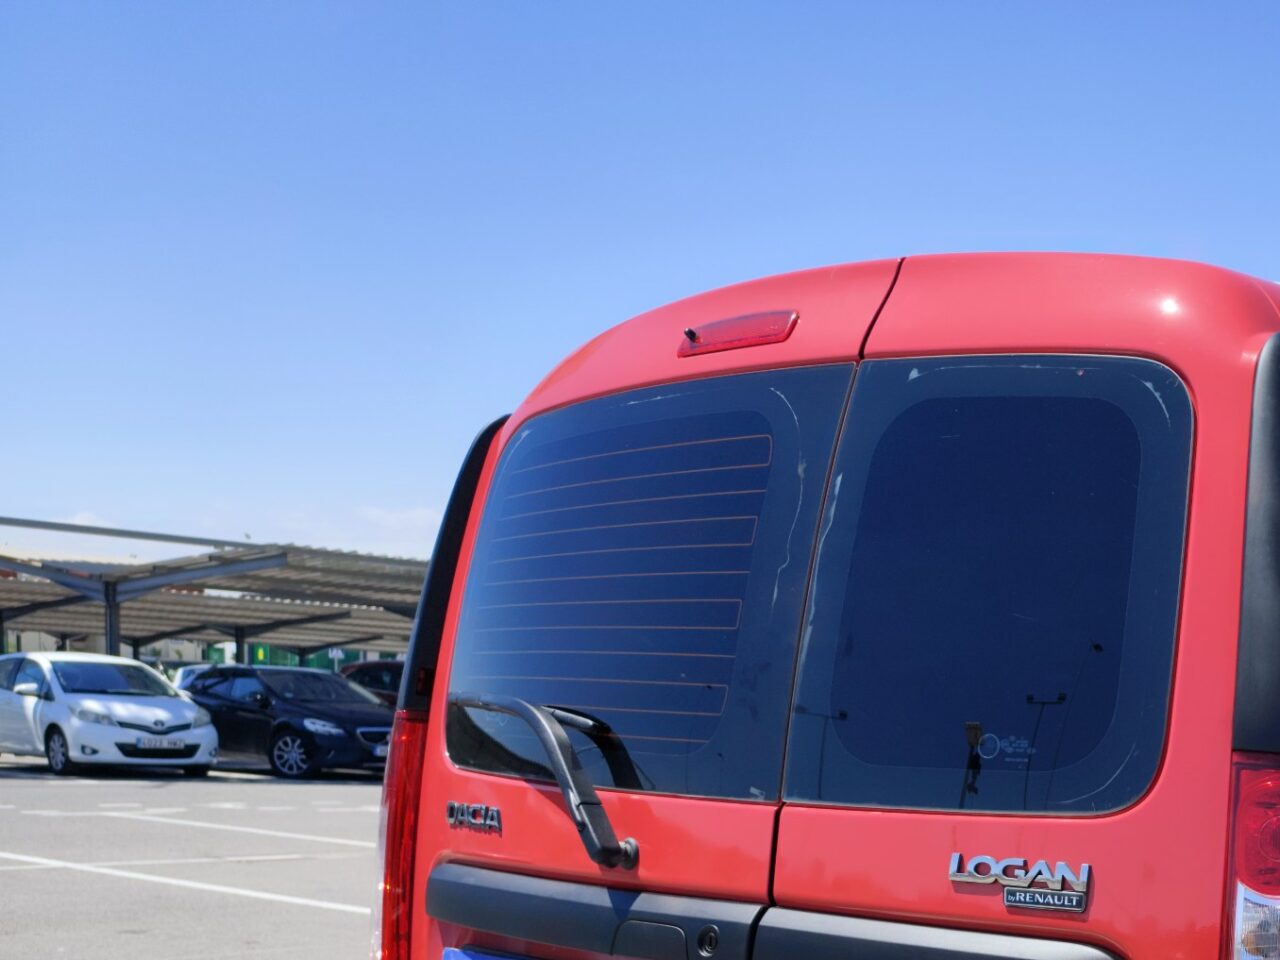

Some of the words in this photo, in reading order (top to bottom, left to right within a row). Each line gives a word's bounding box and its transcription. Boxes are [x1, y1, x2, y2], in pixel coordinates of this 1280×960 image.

[446, 801, 502, 833] DACIA
[948, 852, 1091, 892] LOGAN
[1007, 894, 1016, 902] by
[1015, 891, 1080, 907] RENAULT
